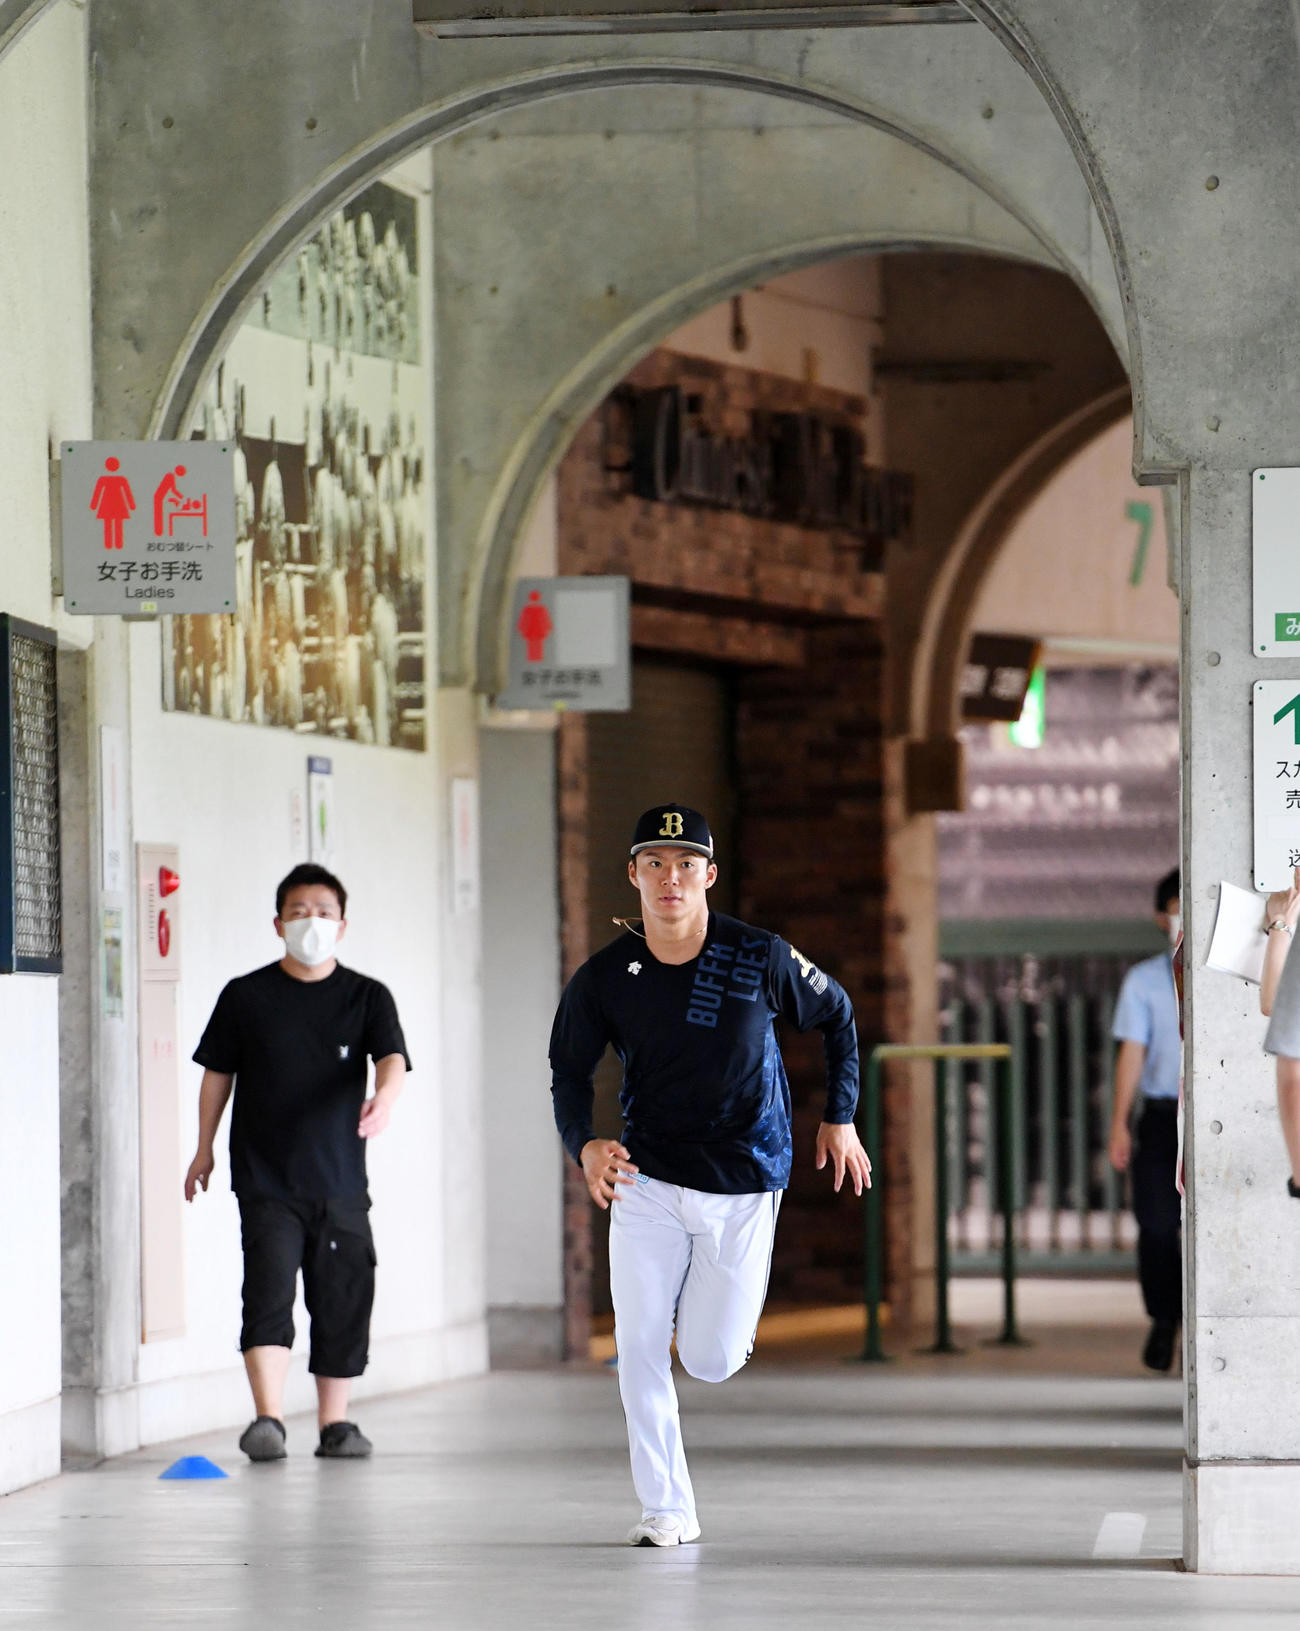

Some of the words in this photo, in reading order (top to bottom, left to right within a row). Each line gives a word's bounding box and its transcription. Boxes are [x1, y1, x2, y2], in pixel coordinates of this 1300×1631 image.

[97, 561, 202, 581] 女子お手洗
[125, 585, 175, 598] Ladies
[658, 812, 684, 838] B
